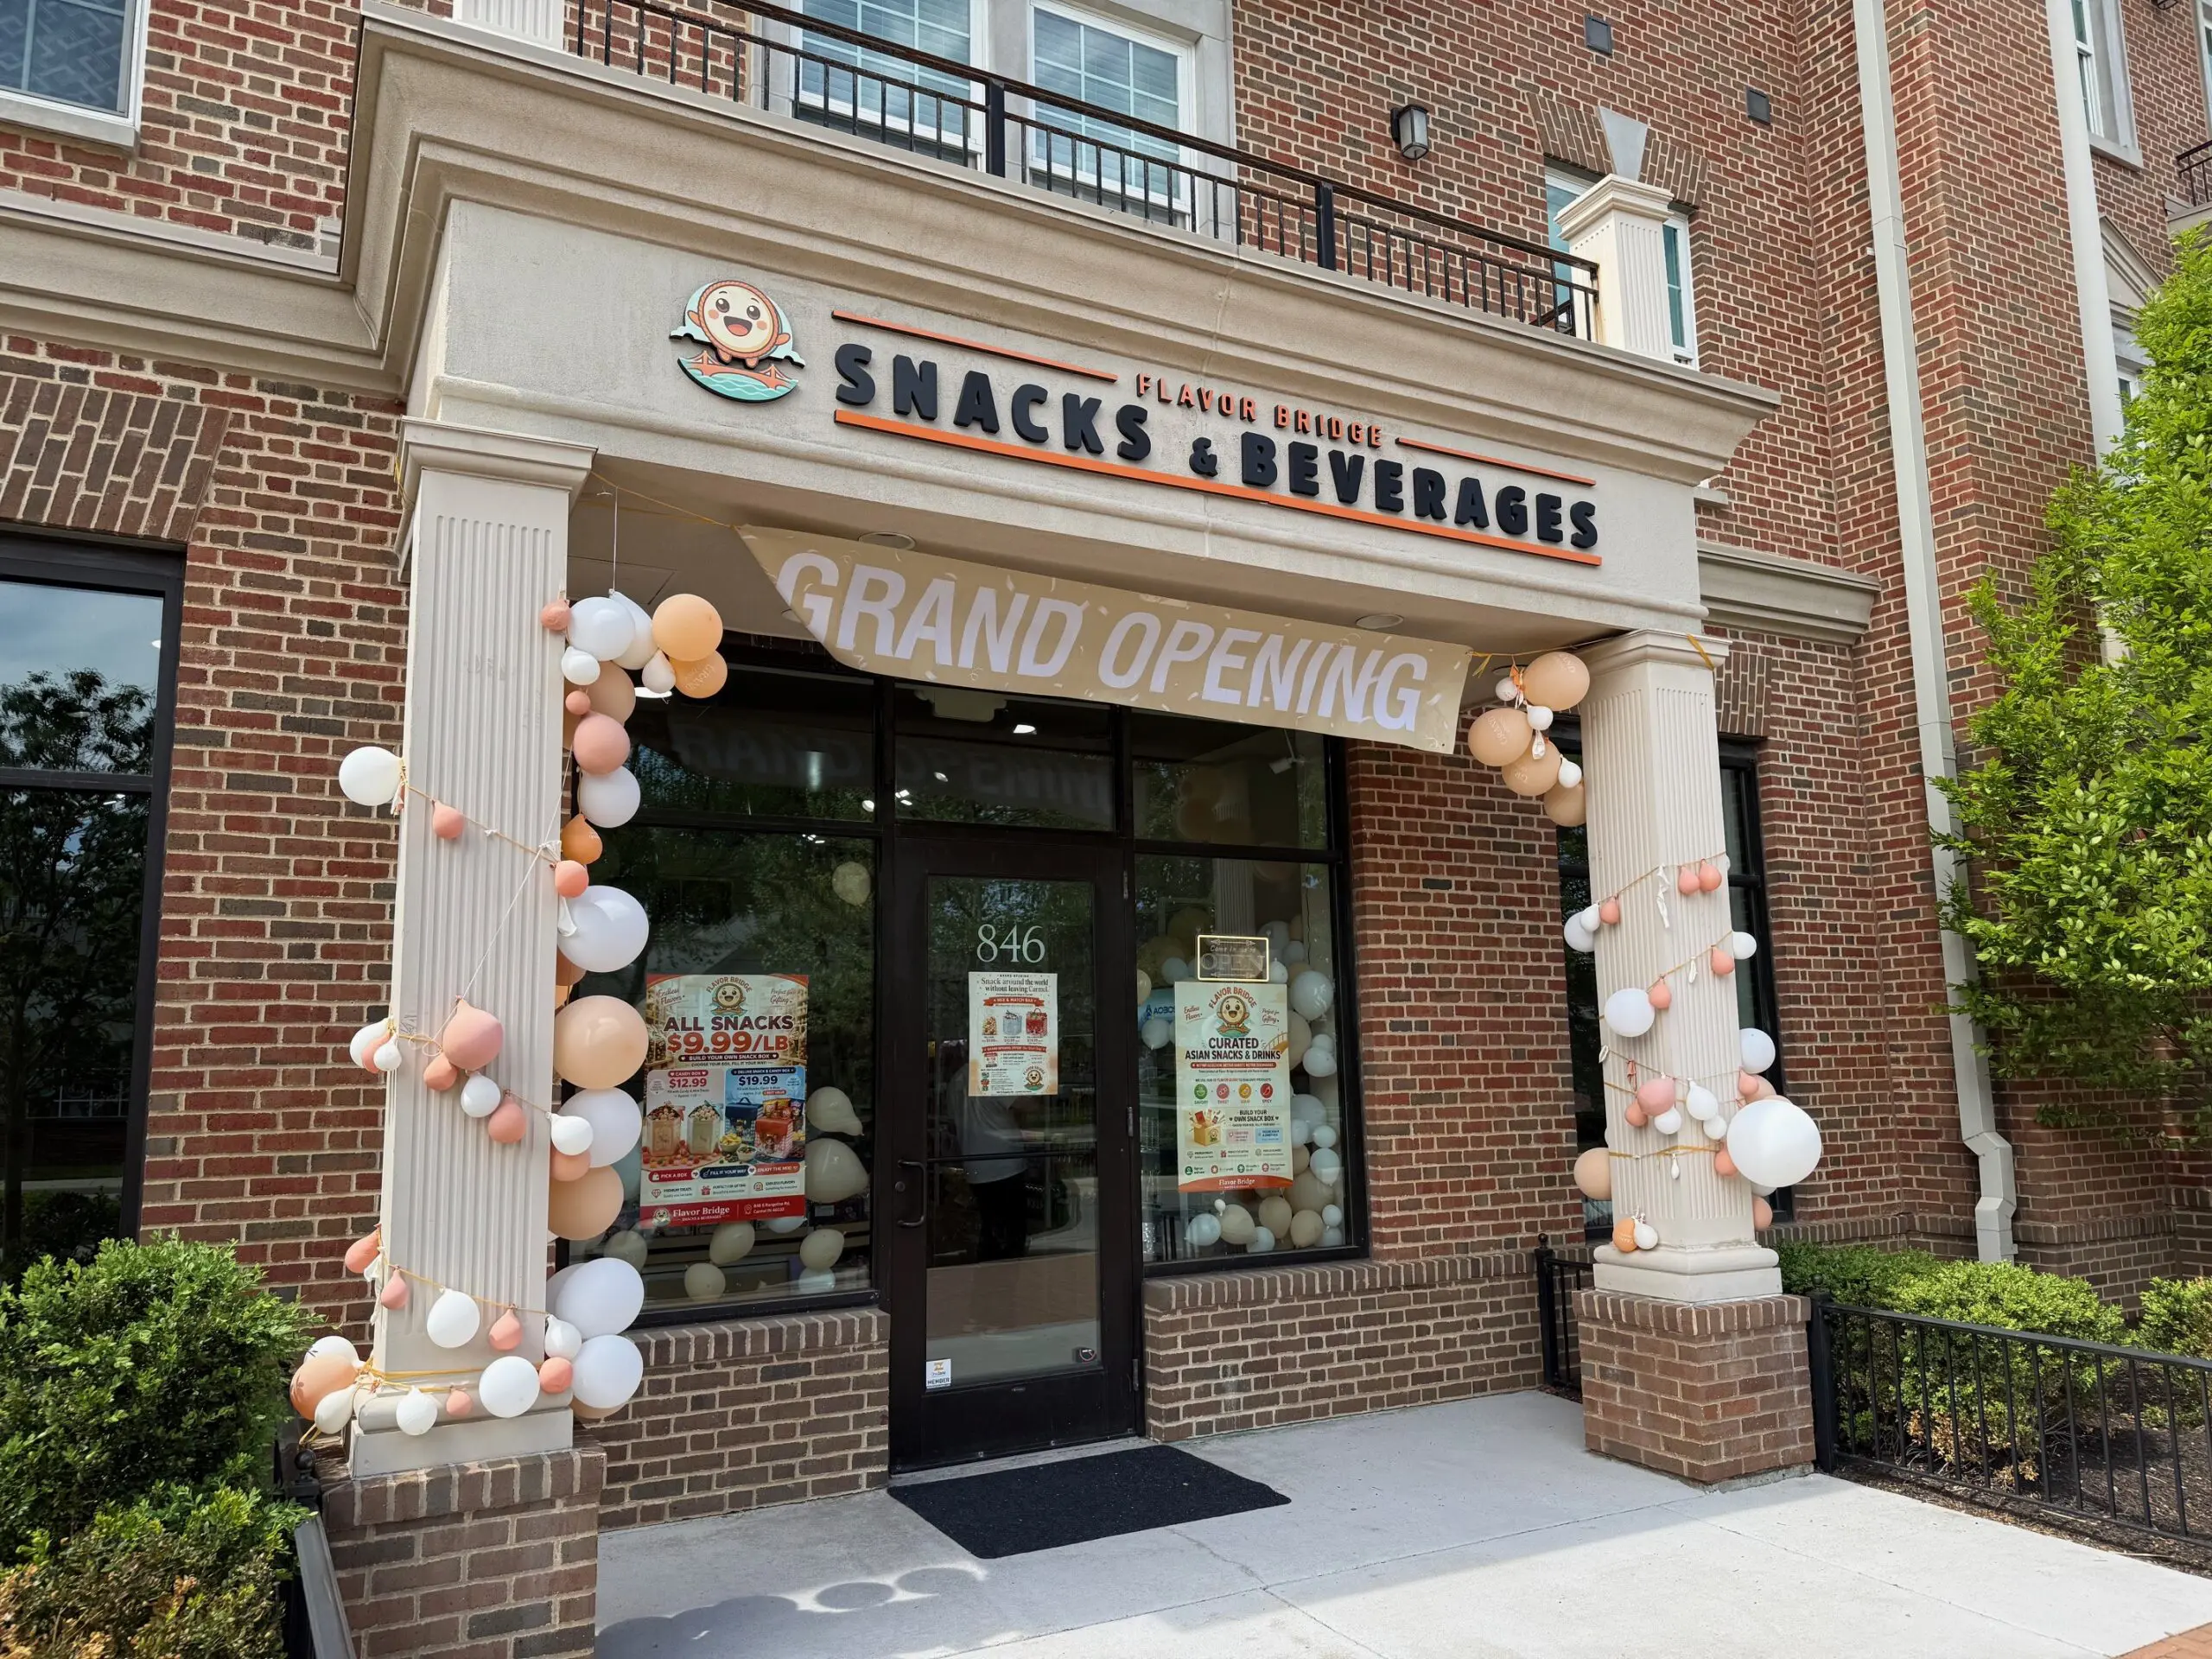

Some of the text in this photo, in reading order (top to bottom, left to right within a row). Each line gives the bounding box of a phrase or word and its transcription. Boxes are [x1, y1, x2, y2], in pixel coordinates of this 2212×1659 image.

[1136, 372, 1382, 448] FLAVOR BRIDGE
[834, 343, 1599, 549] SNACKS & BEVERAGES
[777, 551, 1427, 732] GRAND OPENING
[976, 924, 1046, 963] 846
[706, 976, 753, 994] FLAVOR BRIDGE
[1208, 986, 1257, 1009] FLAVOR BRIDGE
[664, 1015, 793, 1032] ALL SNACKS
[1262, 1015, 1277, 1024] Gifting
[667, 1031, 789, 1054] $9.99/LB
[1208, 1037, 1259, 1049] CURATED
[1185, 1050, 1281, 1060] ASIAN SNACKS & DRINKS
[669, 1077, 707, 1089] $12.99
[739, 1076, 779, 1086] $19.99
[673, 1205, 730, 1217] Flavor Bridge
